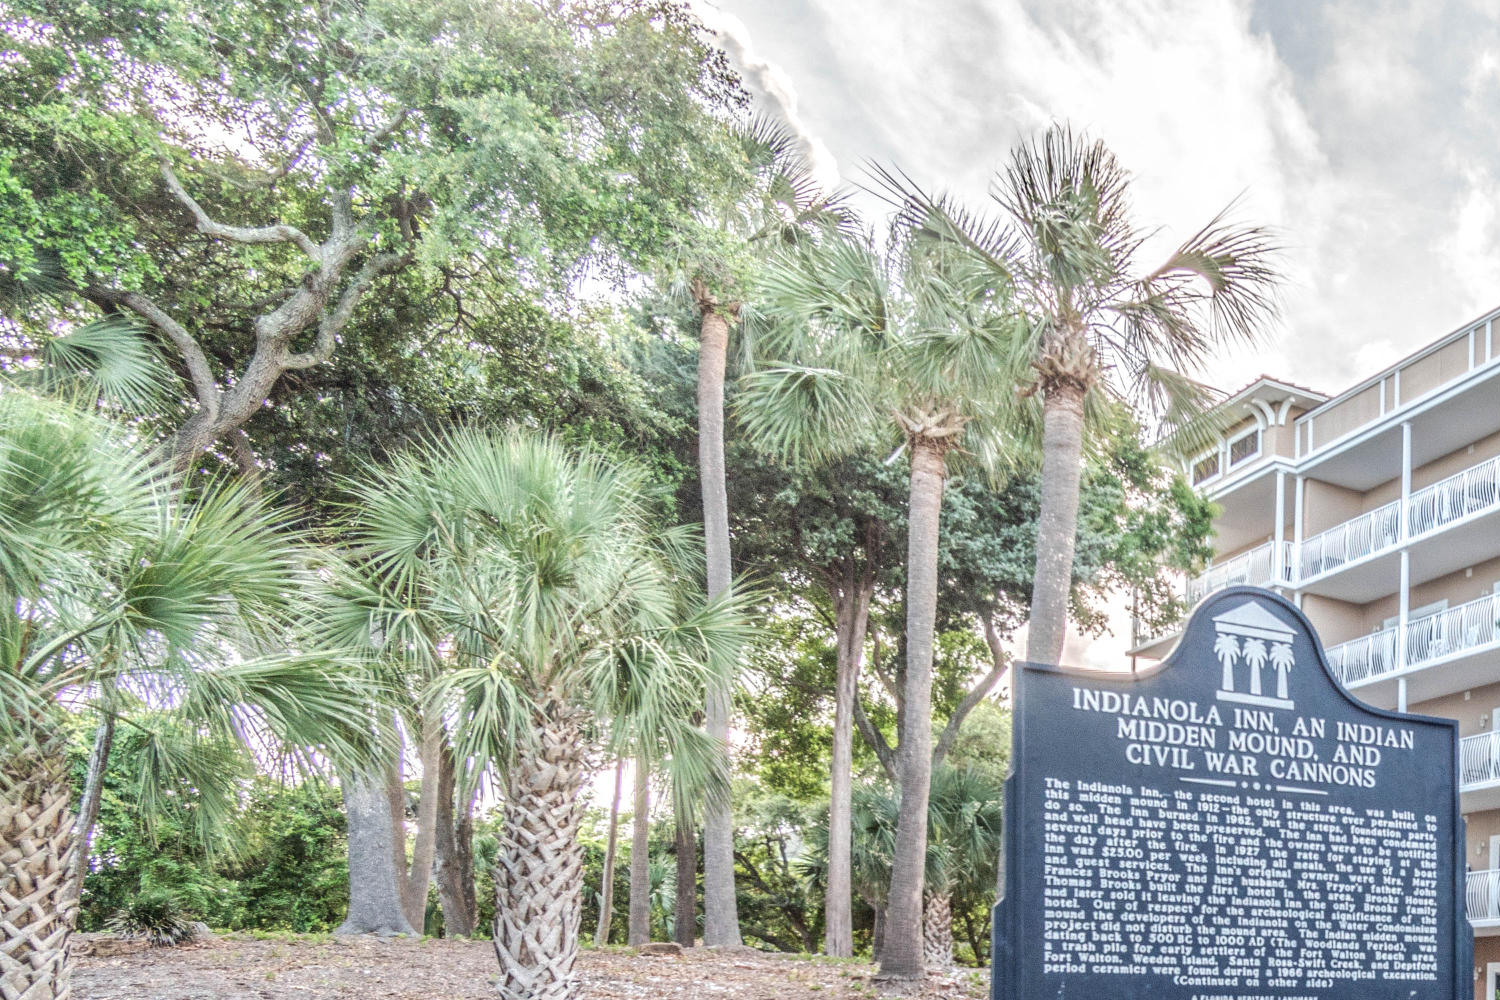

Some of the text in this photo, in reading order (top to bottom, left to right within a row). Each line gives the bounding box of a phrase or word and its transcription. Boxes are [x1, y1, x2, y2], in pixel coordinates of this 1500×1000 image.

[1073, 687, 1413, 749] INDIANOLA INN, AN INDIAN
[1117, 717, 1381, 767] MIDDEN MOUND, AND
[1125, 743, 1376, 788] CIVIL WAR CANNONS
[1044, 778, 1415, 820] The Indianola second hotel this built
[1044, 789, 1417, 832] this midden mound only structure ever permitted
[1044, 799, 1401, 838] do so. The burned foundation
[1044, 810, 1436, 850] and well head have been preserved. been condemned
[1044, 821, 1437, 859] several days prior fire owners were notified
[1044, 832, 1390, 867] the day after fire. 1927 rate staying
[1044, 843, 1064, 854] Inn
[1070, 846, 1094, 856] was
[1178, 852, 1208, 863] week
[1215, 854, 1267, 869] including
[1413, 868, 1436, 878] boat
[1044, 854, 1067, 865] and
[1075, 856, 1109, 870] guest
[1118, 858, 1172, 871] services.
[1215, 865, 1241, 875] Inn's
[1247, 867, 1291, 880] original
[1301, 872, 1339, 881] owners
[1348, 875, 1374, 883] were
[1412, 877, 1437, 889] Mary
[1043, 875, 1399, 904] Thomas Brooks built first hotel Brooks
[1044, 864, 1436, 896] Frances Brooks Pryor husband. Mrs. Pryor's John
[1044, 886, 1437, 917] and later sold leaving Indianola only Brooks family
[1044, 897, 1392, 924] hotel. Out respect archeological significance
[1044, 908, 1437, 933] mound the developers Indianola Water Condominium
[1044, 919, 1397, 941] project disturb mound area. Indian midden
[1043, 930, 1359, 949] dating back 1000 (The Woodlands
[1061, 941, 1096, 952] trash
[1103, 942, 1127, 955] pile
[1159, 944, 1193, 956] early
[1199, 945, 1245, 956] settlers
[1300, 948, 1322, 958] Fort
[1330, 949, 1365, 959] Walton
[1375, 951, 1404, 960] Beach
[1043, 962, 1086, 975] period
[1092, 963, 1146, 974] ceramics
[1151, 967, 1180, 975] were
[1187, 965, 1219, 975] found
[1223, 966, 1259, 978] during
[1277, 967, 1303, 977] 1966
[1306, 968, 1376, 980] archeological
[1044, 951, 1072, 962] Fort
[1132, 954, 1177, 964] Weeden
[1228, 956, 1261, 966] Santa
[1393, 961, 1437, 972] Deptford
[1173, 975, 1238, 986] (Continued
[1267, 977, 1298, 987] other
